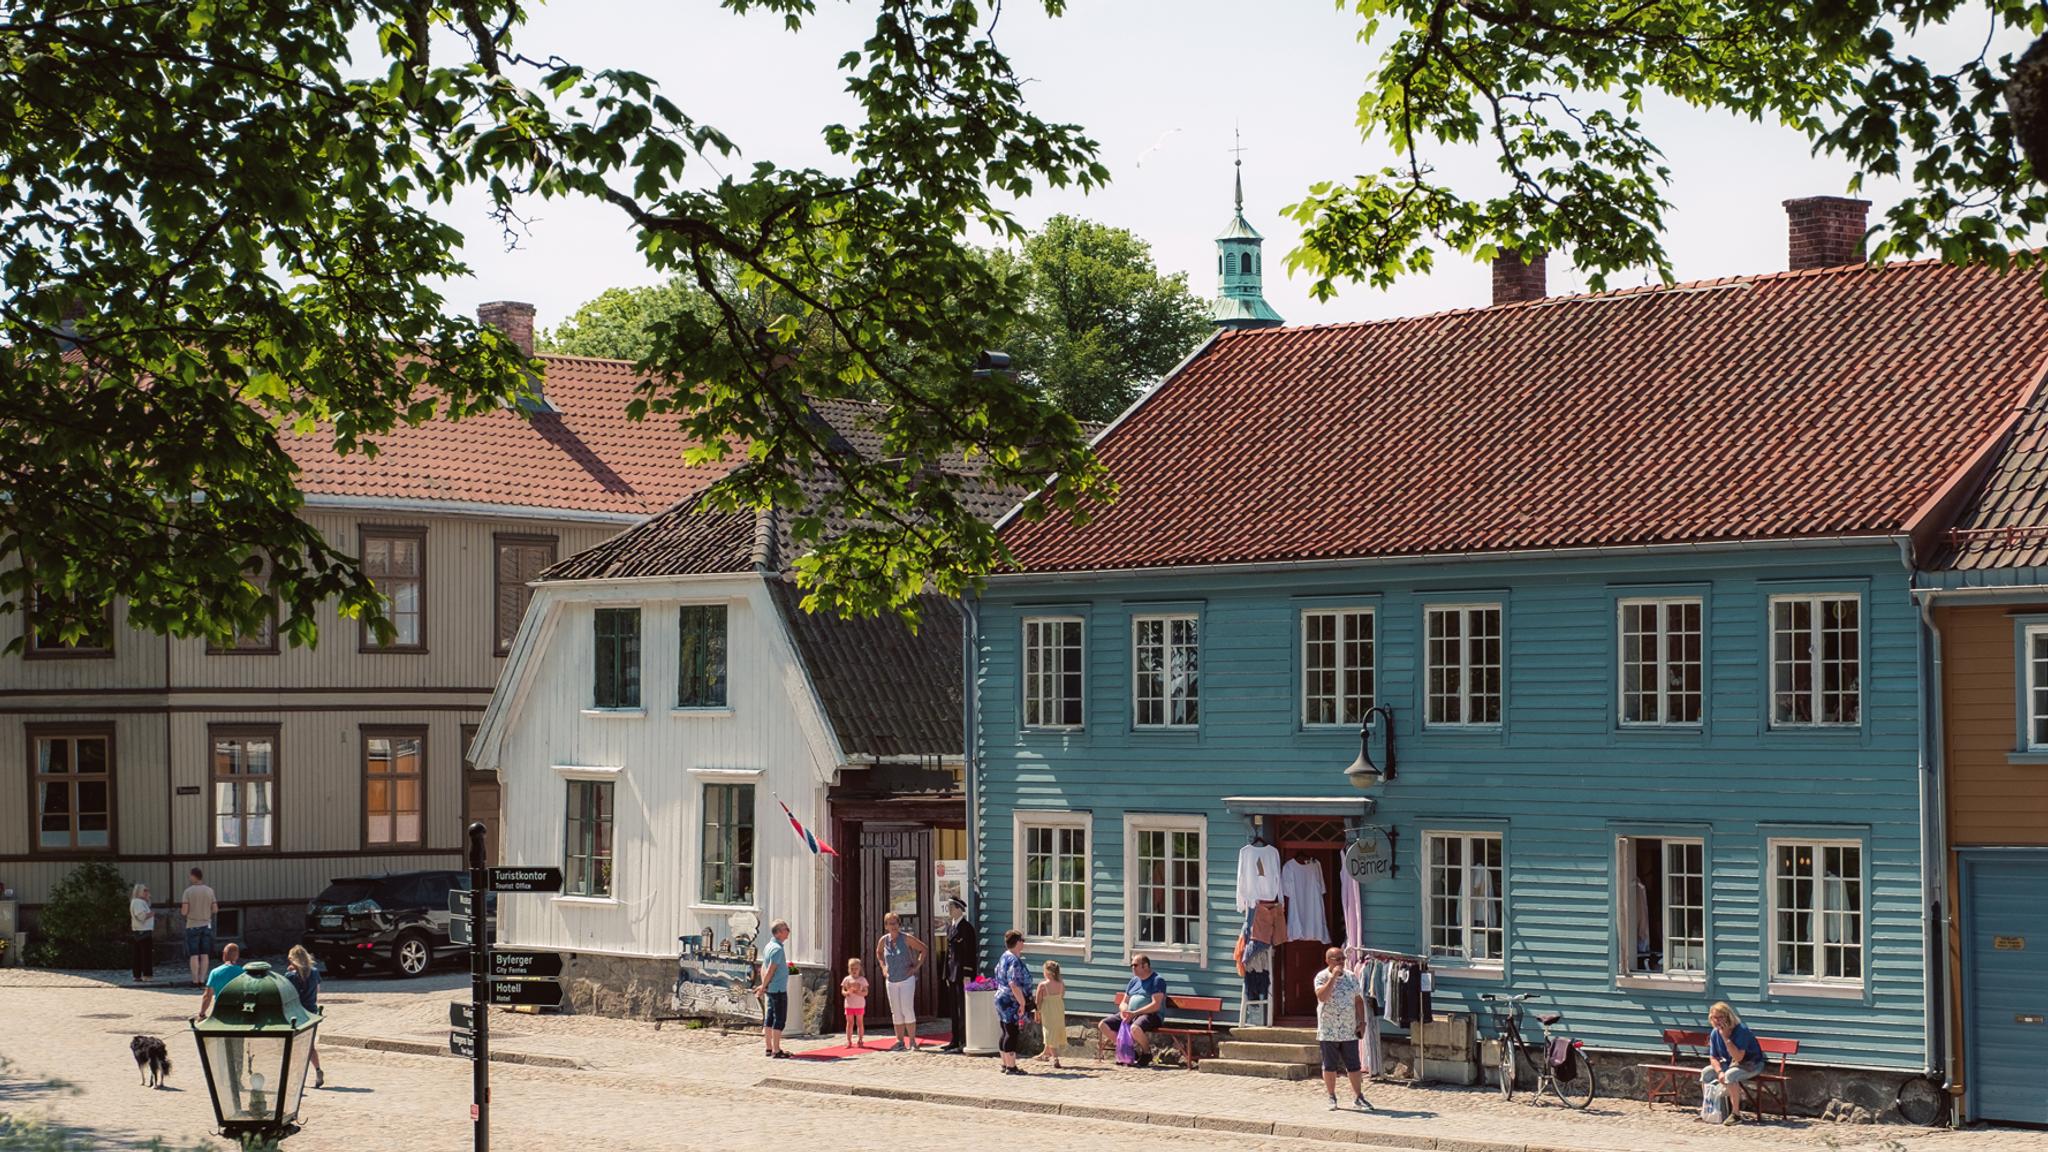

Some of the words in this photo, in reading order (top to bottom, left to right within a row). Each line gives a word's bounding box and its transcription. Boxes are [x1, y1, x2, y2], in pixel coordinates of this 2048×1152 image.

[1351, 858, 1388, 876] Damer
[495, 870, 547, 880] Turistkontor
[496, 954, 533, 966] Byferger
[496, 966, 507, 974] City
[508, 966, 527, 974] Ferries
[496, 983, 521, 993] Hotell
